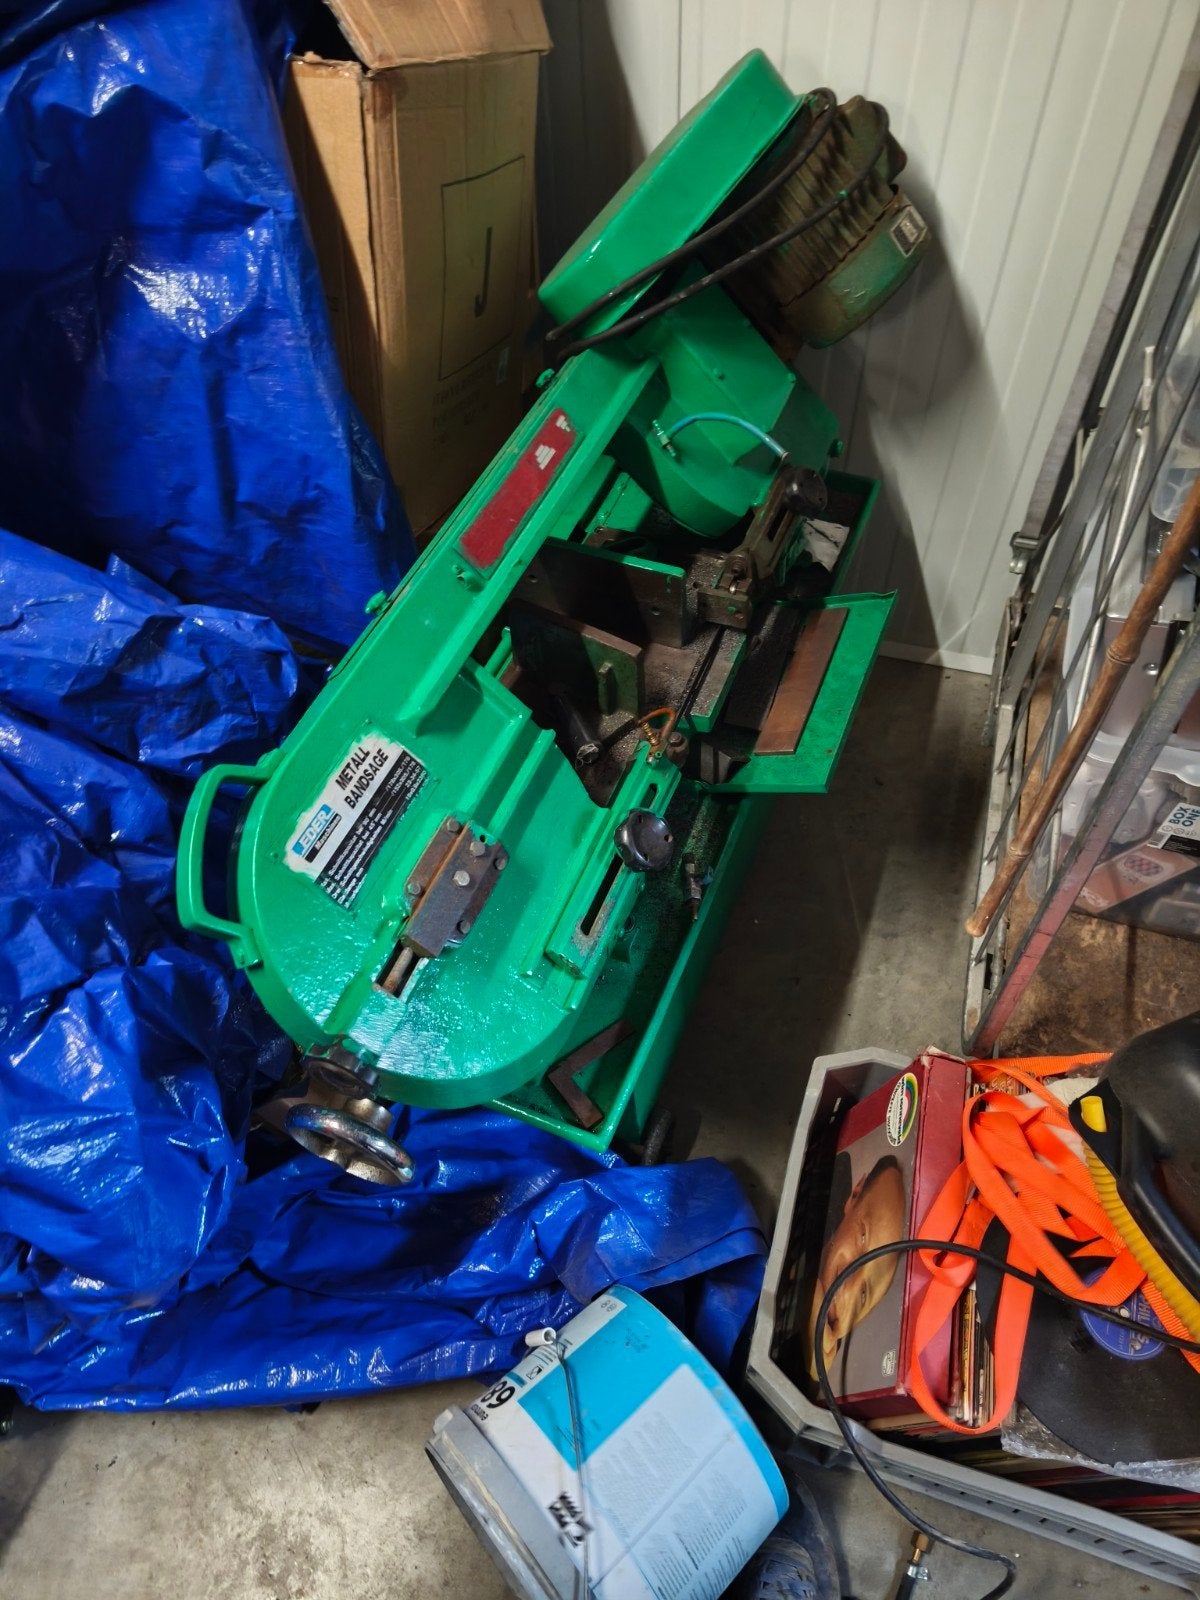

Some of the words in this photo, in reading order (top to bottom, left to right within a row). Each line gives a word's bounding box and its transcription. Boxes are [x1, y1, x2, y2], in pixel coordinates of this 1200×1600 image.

[335, 747, 371, 791] METALL
[300, 811, 329, 848] EDER
[1169, 806, 1191, 825] BOX
